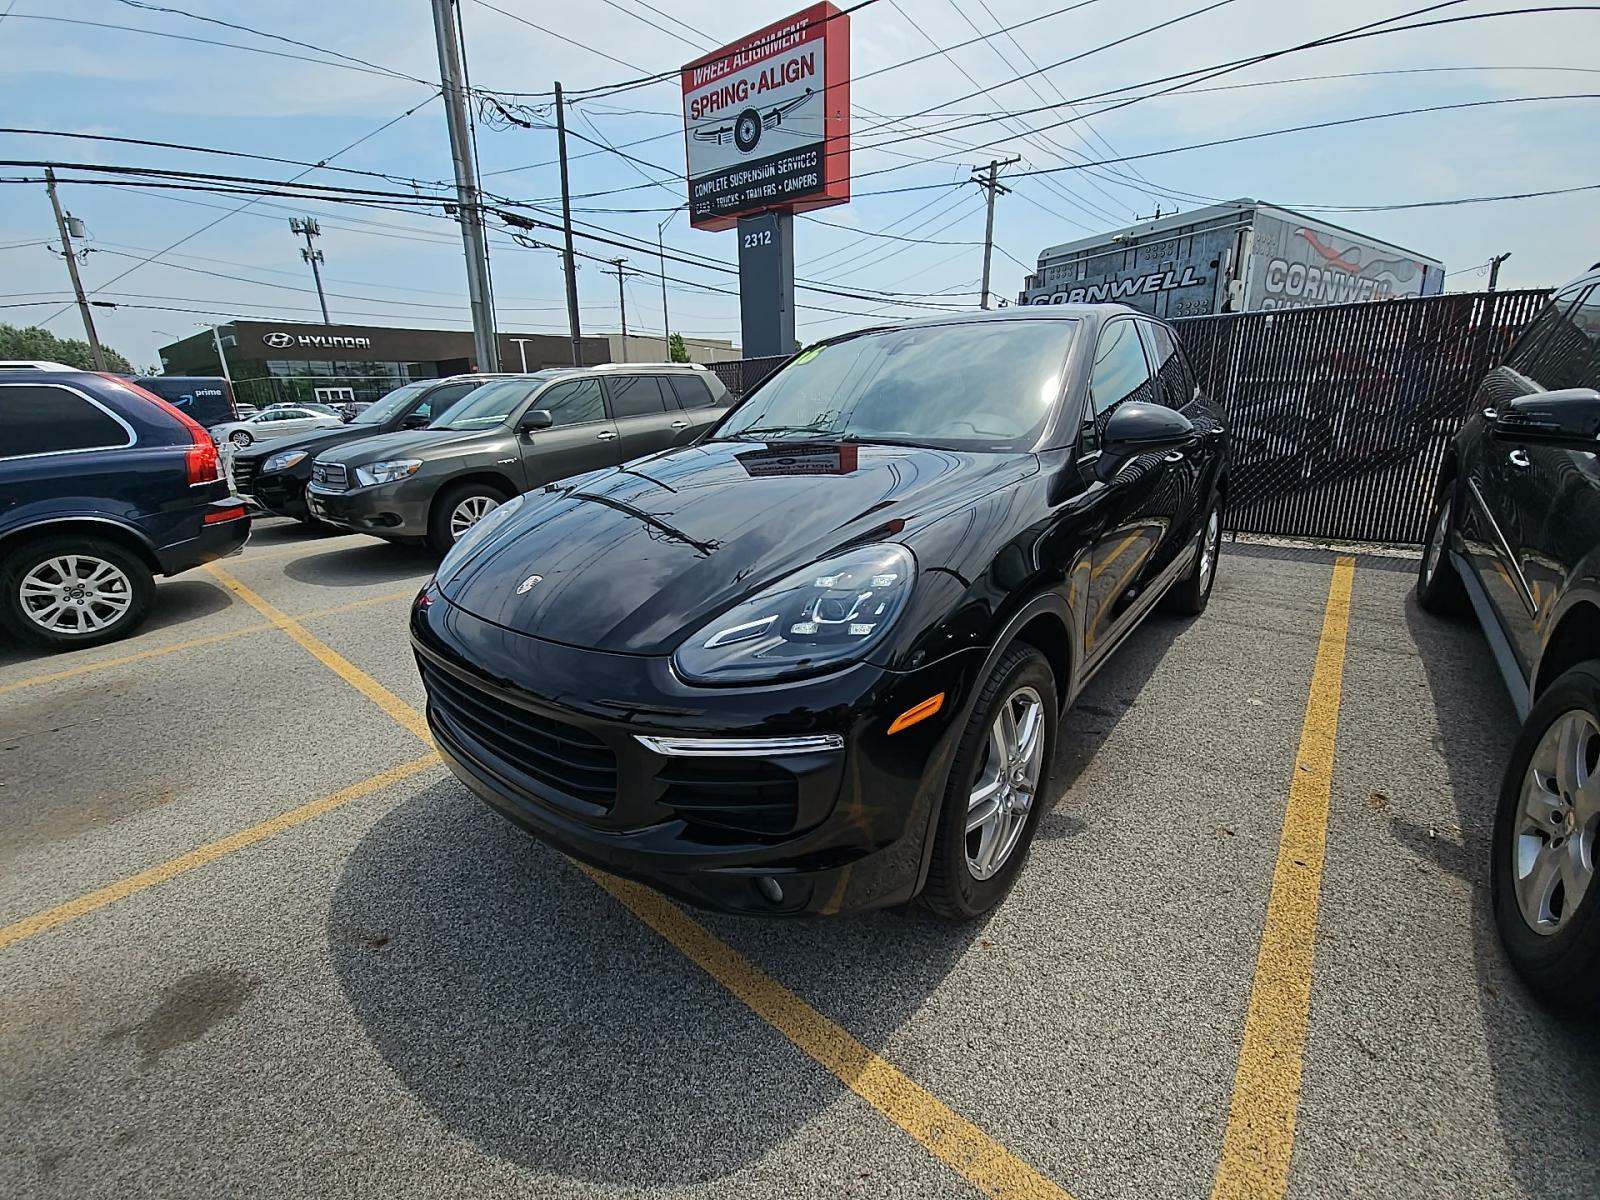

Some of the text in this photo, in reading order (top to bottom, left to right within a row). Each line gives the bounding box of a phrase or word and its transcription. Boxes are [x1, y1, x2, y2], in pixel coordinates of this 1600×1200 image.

[693, 18, 809, 86] WHEEL ALIGNMENT
[691, 52, 815, 120] SPRING ALIGN
[694, 151, 817, 198] COMPLETE SUSPENSION SERVICES
[745, 183, 777, 200] TRAILERS
[783, 173, 818, 192] CAMPERS
[744, 230, 772, 248] 2312
[1031, 267, 1200, 305] CORNWELL
[298, 335, 370, 349] HYUNDAI
[195, 388, 222, 398] prime
